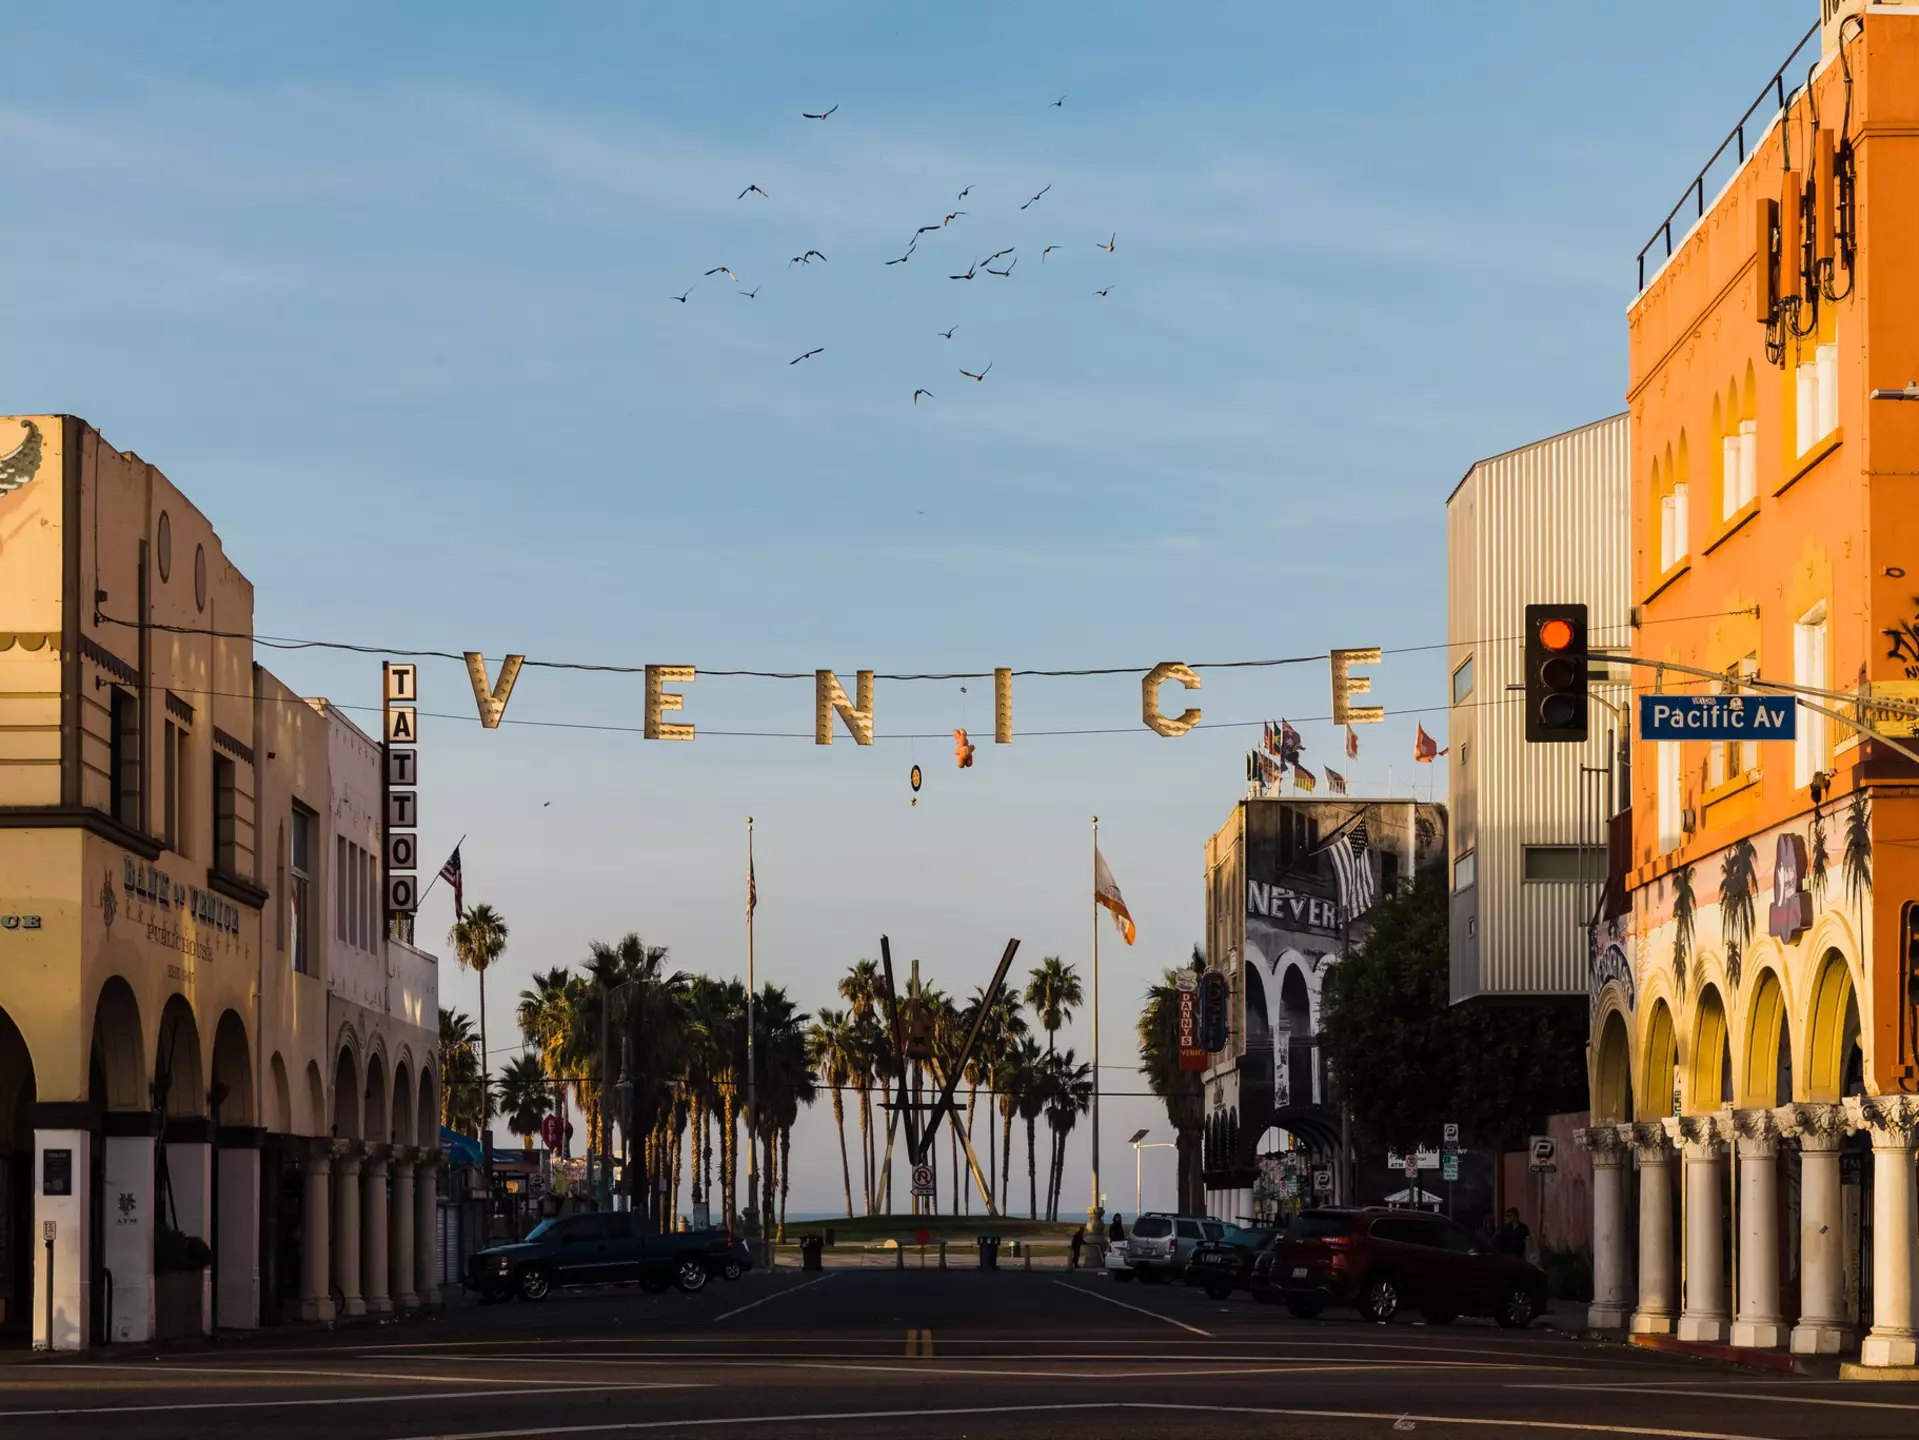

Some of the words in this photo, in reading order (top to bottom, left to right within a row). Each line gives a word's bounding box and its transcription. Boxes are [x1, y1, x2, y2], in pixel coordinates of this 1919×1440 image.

[463, 647, 1384, 745] VENICE
[1654, 704, 1744, 728] Pacific
[1753, 705, 1786, 728] Av
[392, 669, 411, 900] TATTOO
[124, 856, 170, 907] BANK
[182, 937, 213, 963] HOUSE
